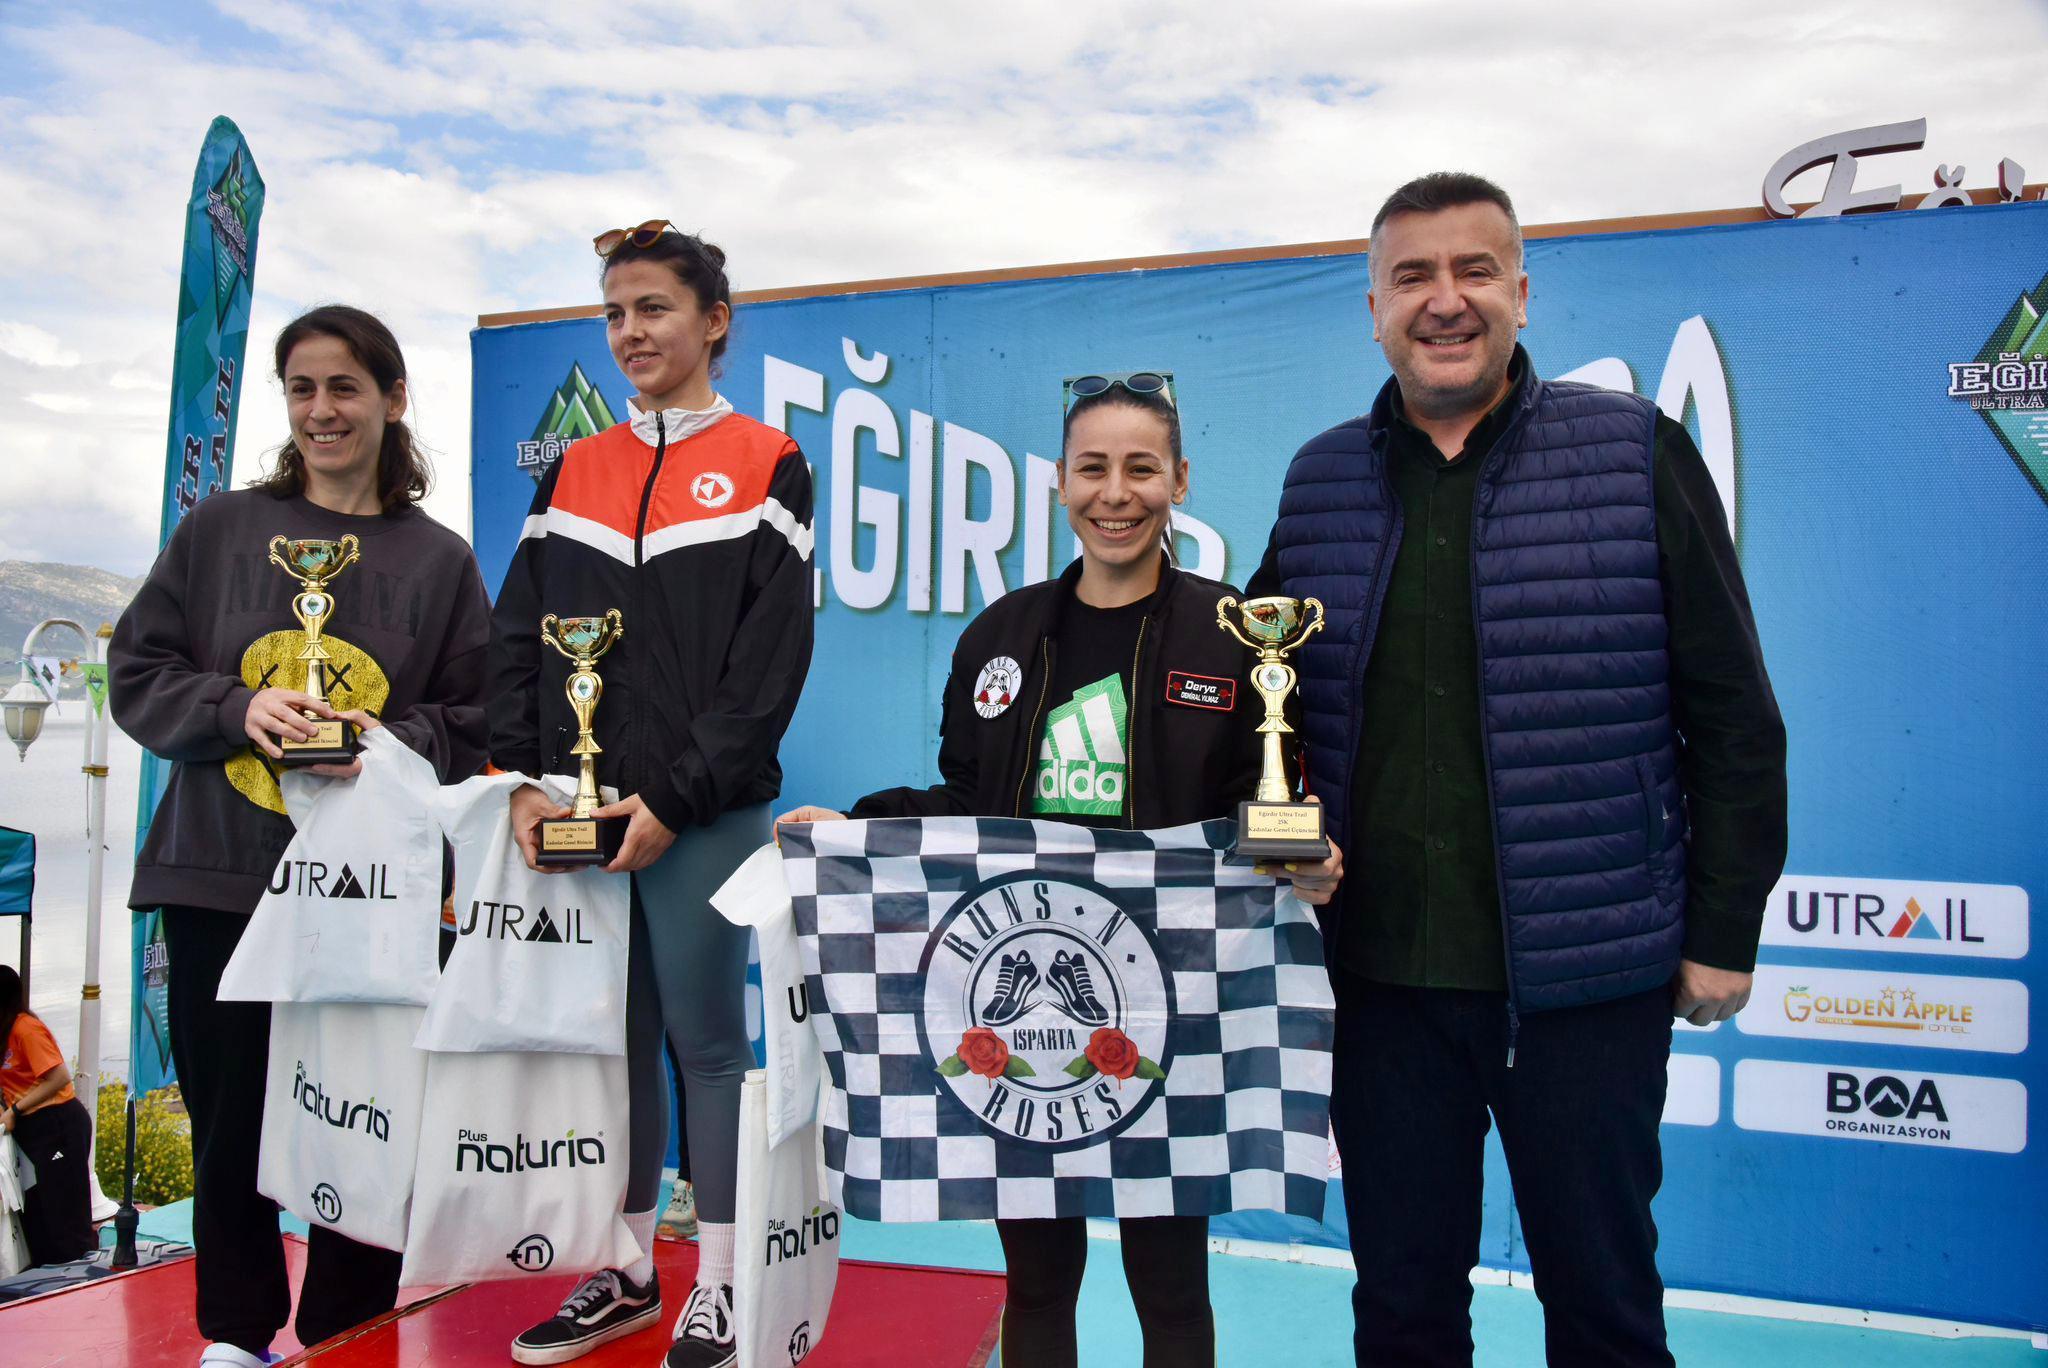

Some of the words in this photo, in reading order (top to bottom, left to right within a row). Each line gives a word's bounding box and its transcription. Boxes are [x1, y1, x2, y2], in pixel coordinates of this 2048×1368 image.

[1970, 392, 2045, 410] ULTRA
[228, 553, 420, 638] NIANA
[1185, 680, 1217, 694] Derya
[1033, 759, 1124, 802] dida
[941, 882, 1051, 963] RUNS
[1094, 908, 1128, 947] N
[1787, 890, 1985, 943] UTRAIL
[1784, 990, 1895, 1023] GOLDEN
[1903, 1001, 1972, 1023] APPLE
[1013, 1028, 1077, 1050] ISPARTA
[293, 1072, 390, 1142] naturia
[981, 1081, 1122, 1141] ROSES
[1826, 1071, 1949, 1122] BOA
[456, 1129, 605, 1174] naturia
[458, 1129, 488, 1142] Plus
[1825, 1119, 1951, 1141] ORGANIZASYON
[767, 1218, 785, 1234] Plus
